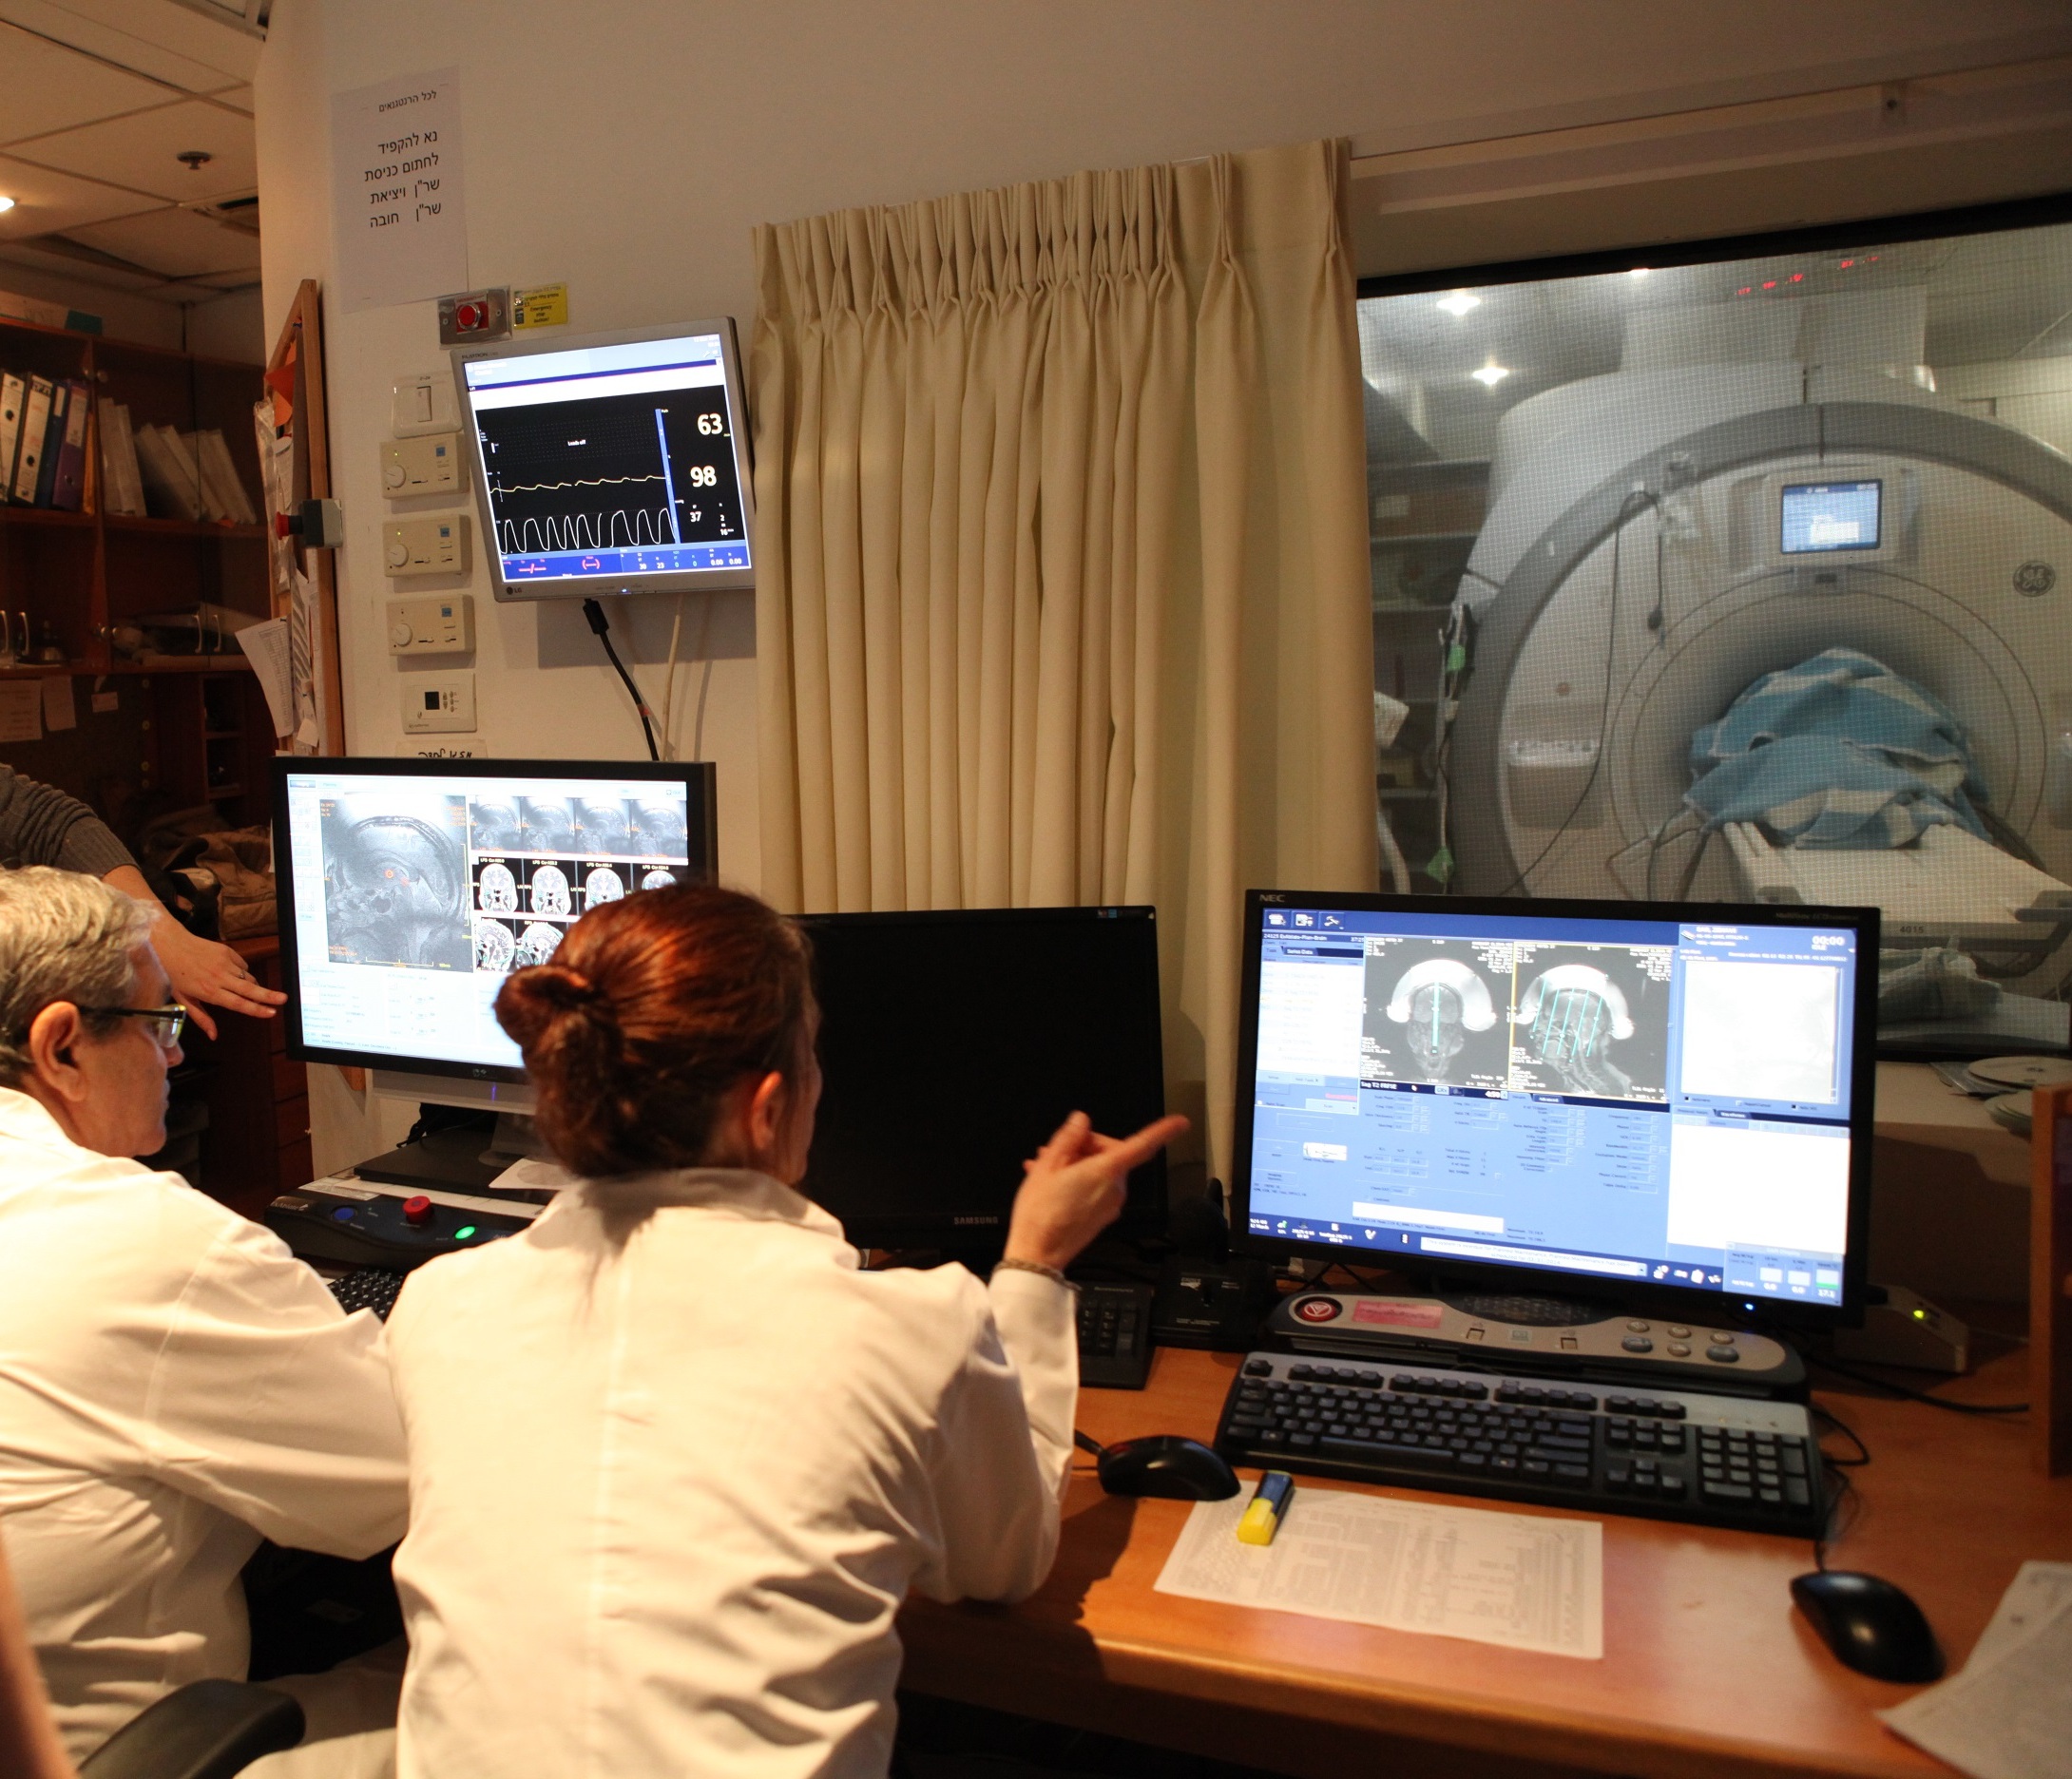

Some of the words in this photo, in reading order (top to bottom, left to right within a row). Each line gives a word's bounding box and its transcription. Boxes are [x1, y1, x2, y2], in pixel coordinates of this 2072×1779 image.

[378, 94, 419, 112] הרנטגנאים
[421, 89, 437, 101] לכל
[377, 132, 419, 154] להקפיד
[424, 130, 437, 143] נא
[402, 152, 439, 173] לחתום
[364, 164, 398, 182] כניסת
[370, 187, 406, 204] ויציאת
[370, 213, 399, 228] חובה
[698, 412, 723, 435] 63
[690, 465, 718, 488] 98
[690, 511, 702, 523] 37
[1812, 936, 1845, 946] 00:00
[953, 1216, 998, 1225] SAMSUNG
